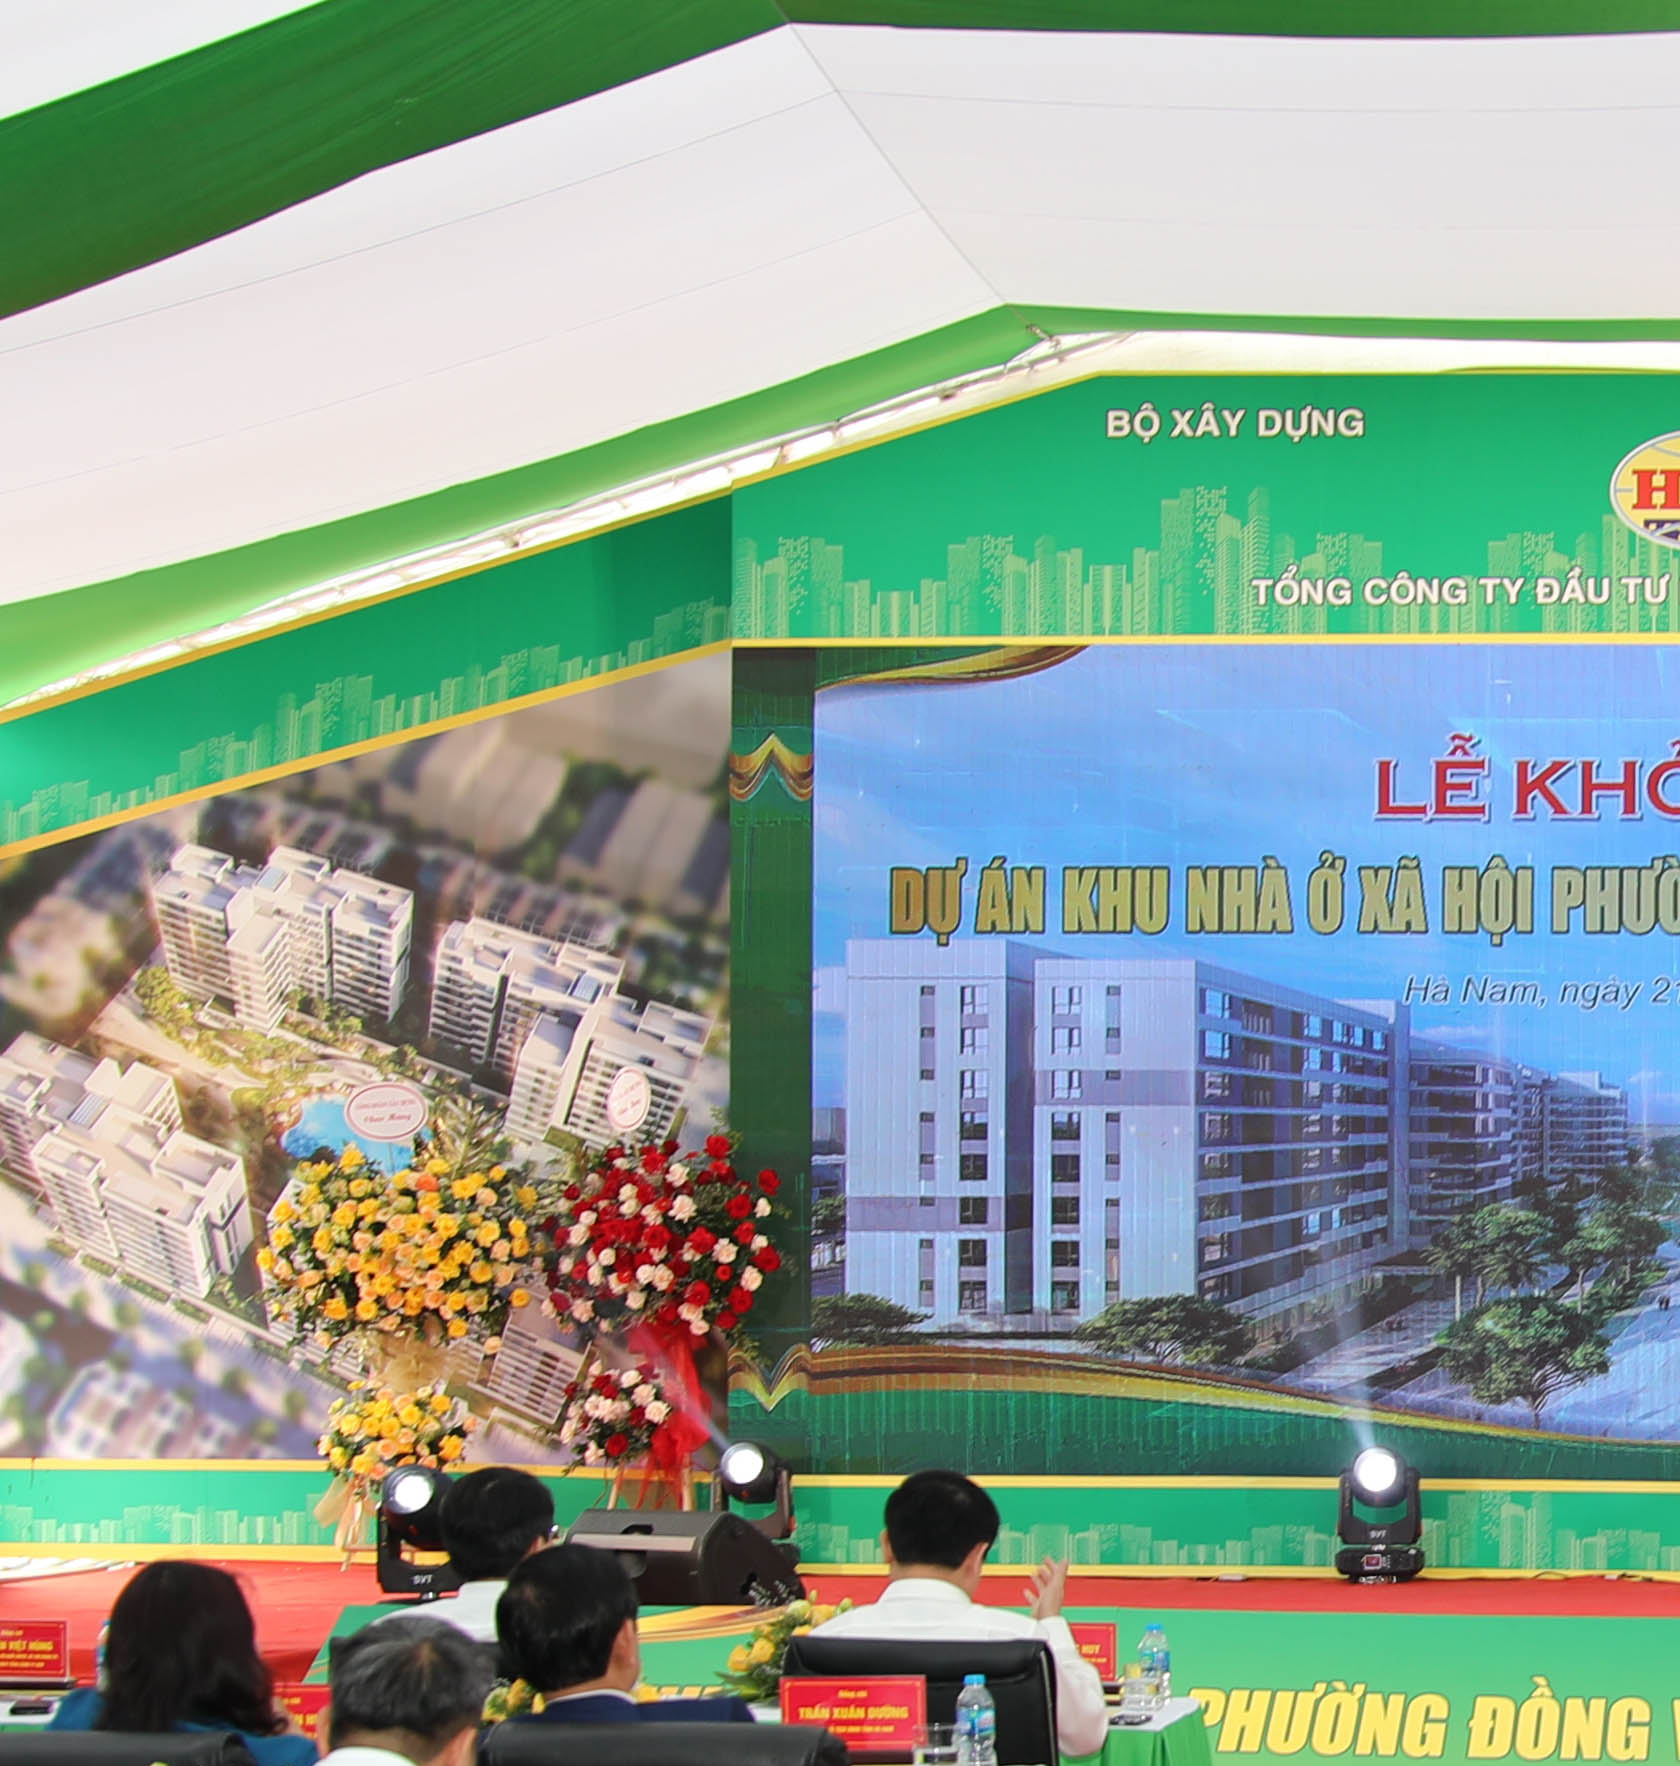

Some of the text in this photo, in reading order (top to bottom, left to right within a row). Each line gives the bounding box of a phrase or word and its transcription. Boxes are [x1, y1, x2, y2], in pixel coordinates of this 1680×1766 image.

[1105, 402, 1366, 444] BỘ XÂY DỰNG
[1251, 564, 1353, 607] TỔNG
[1361, 570, 1468, 607] CÔNG
[1478, 576, 1526, 606] TY
[1534, 565, 1615, 607] ĐẦU
[1621, 573, 1671, 606] TƯ
[1373, 732, 1491, 823] LỄ
[888, 856, 968, 946] DỰ
[975, 855, 1046, 934] ÁN
[1062, 866, 1170, 934] KHU
[1186, 855, 1294, 934] NHÀ
[1307, 850, 1346, 934] Ở
[1357, 855, 1429, 934] XÃ
[1442, 853, 1534, 946] HỘI
[1401, 974, 1453, 1006] Hà
[1460, 976, 1547, 1009] Nam,
[1559, 975, 1648, 1010] ngày
[1187, 1680, 1451, 1758] PHƯỜNG
[1466, 1675, 1652, 1761] ĐỒNG
